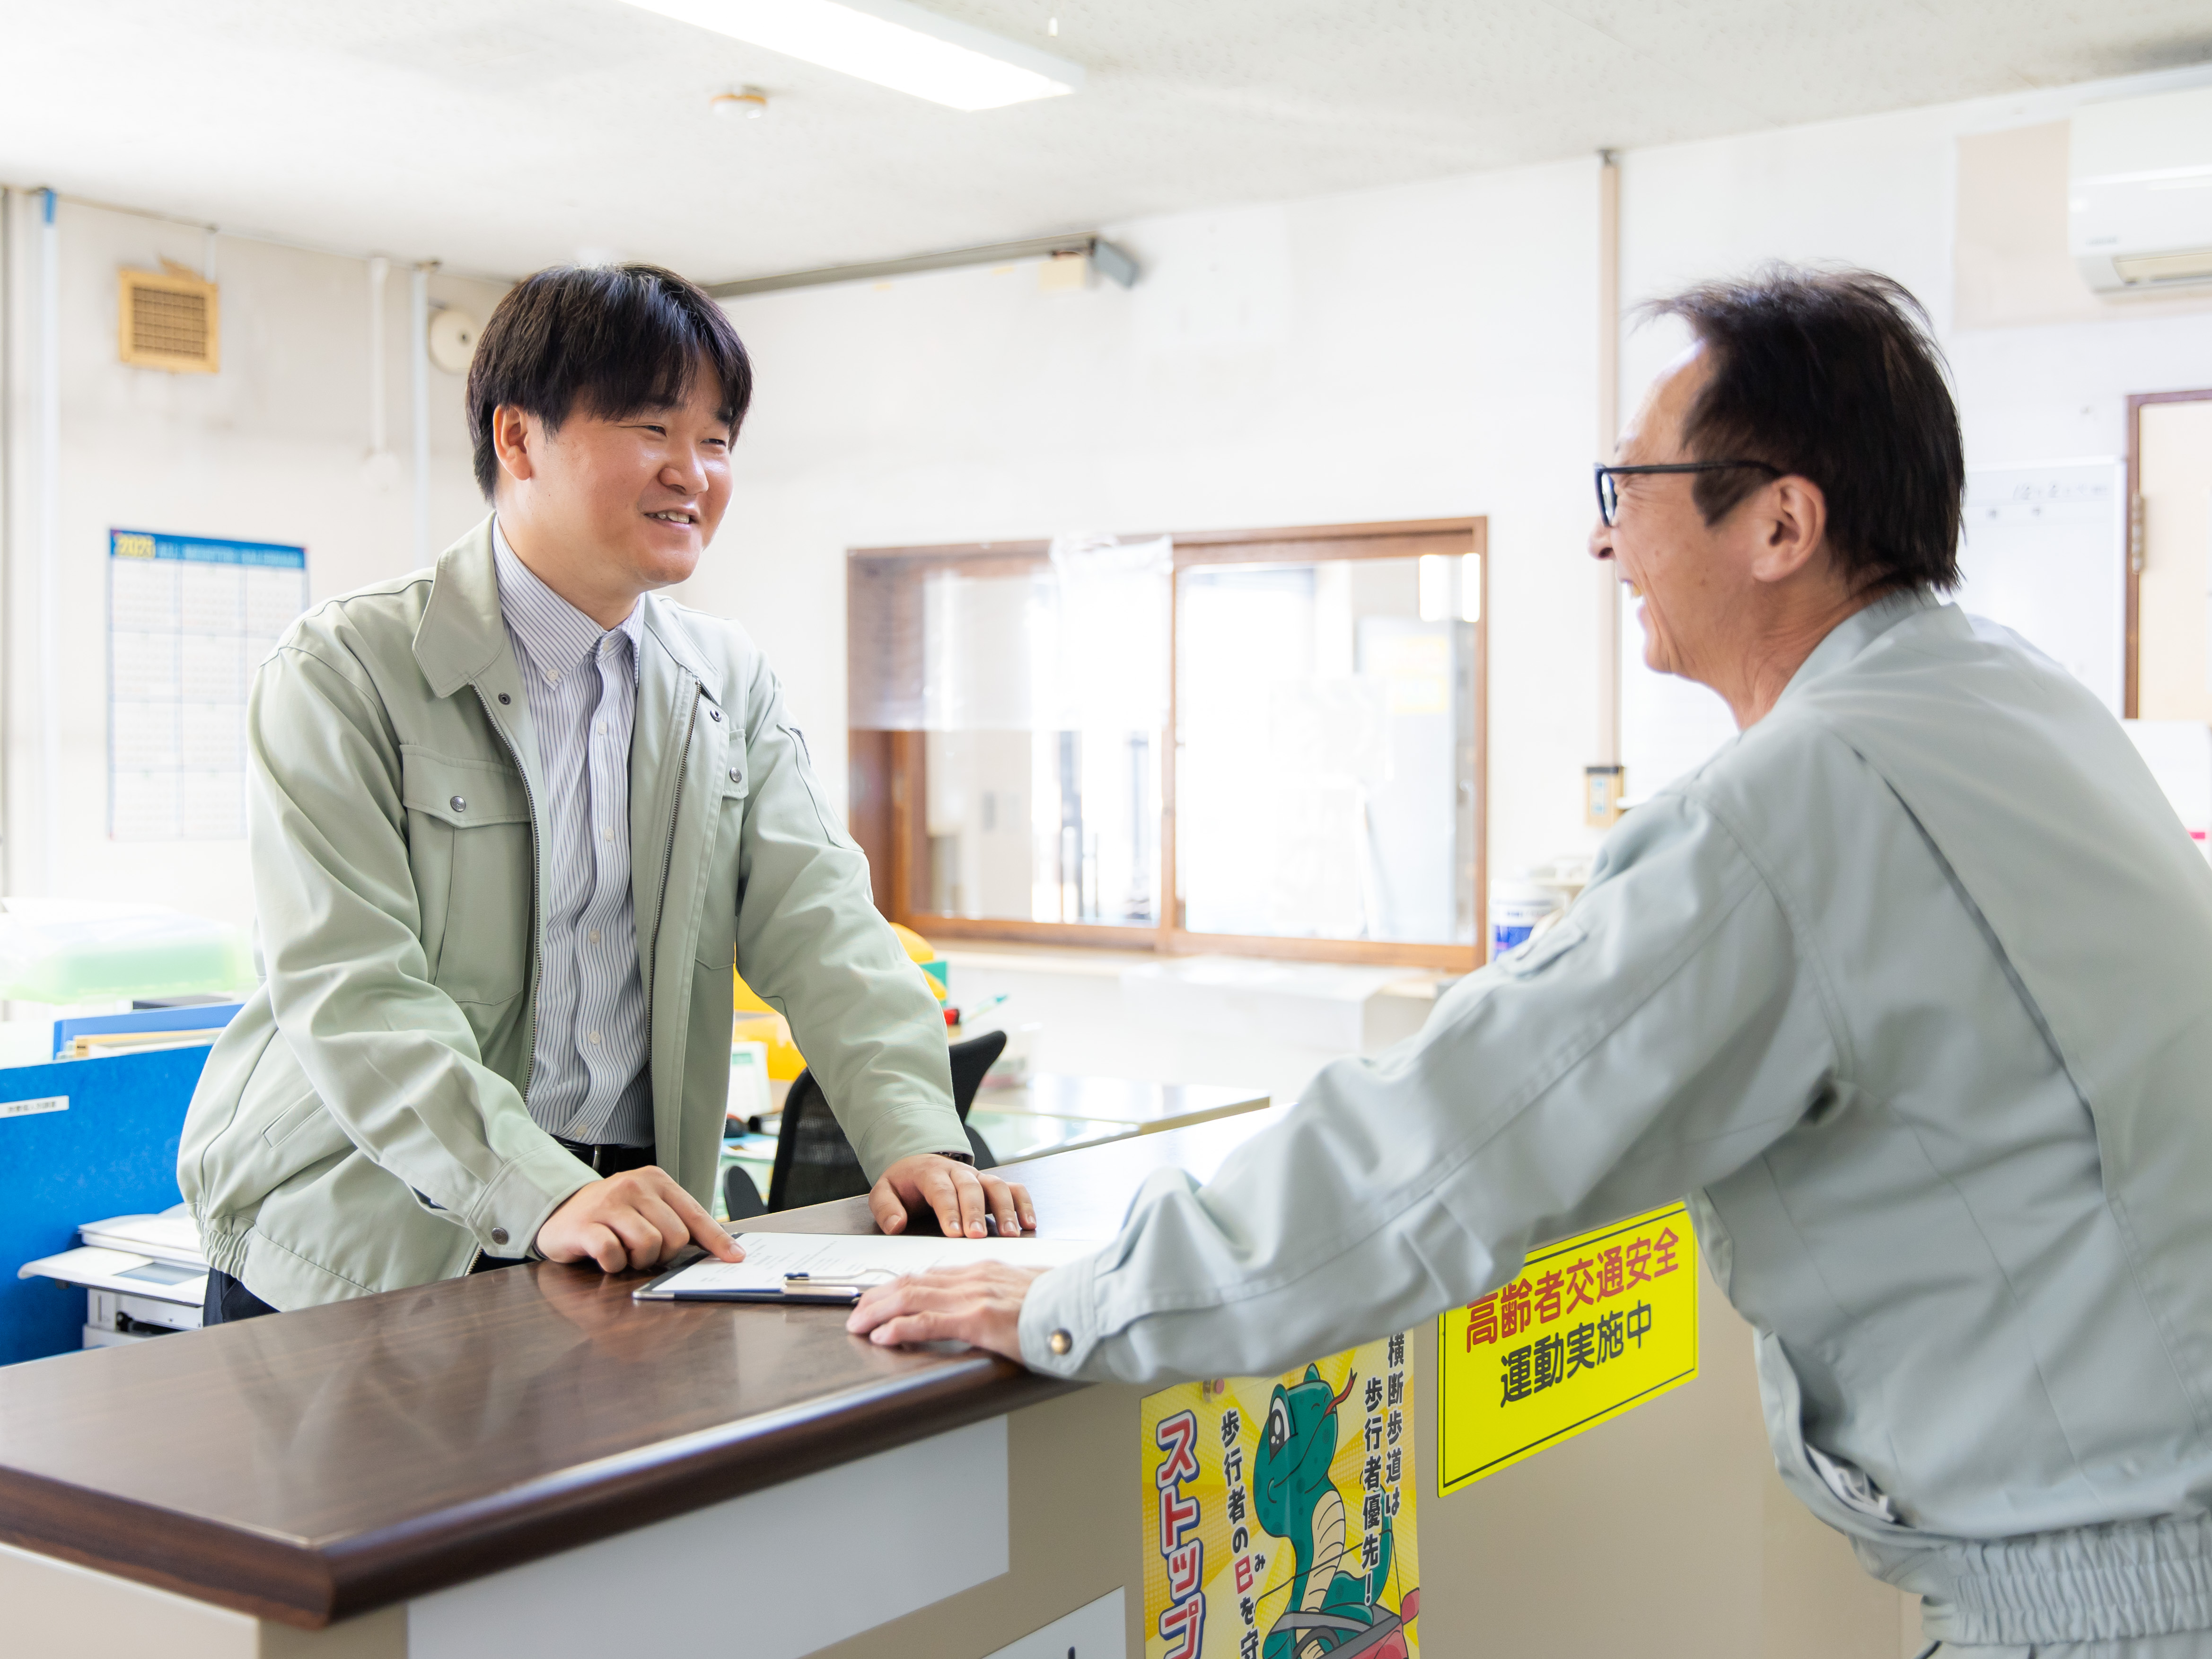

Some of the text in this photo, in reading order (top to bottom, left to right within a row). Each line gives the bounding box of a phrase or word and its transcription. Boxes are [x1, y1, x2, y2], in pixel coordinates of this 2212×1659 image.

[1467, 1227, 1679, 1352] 高齢者交通安全
[1501, 1300, 1650, 1408] 運動実施中
[1385, 1332, 1404, 1516] 横断歩道は
[1157, 1411, 1204, 1659] ストップ
[1255, 1554, 1265, 1572] み
